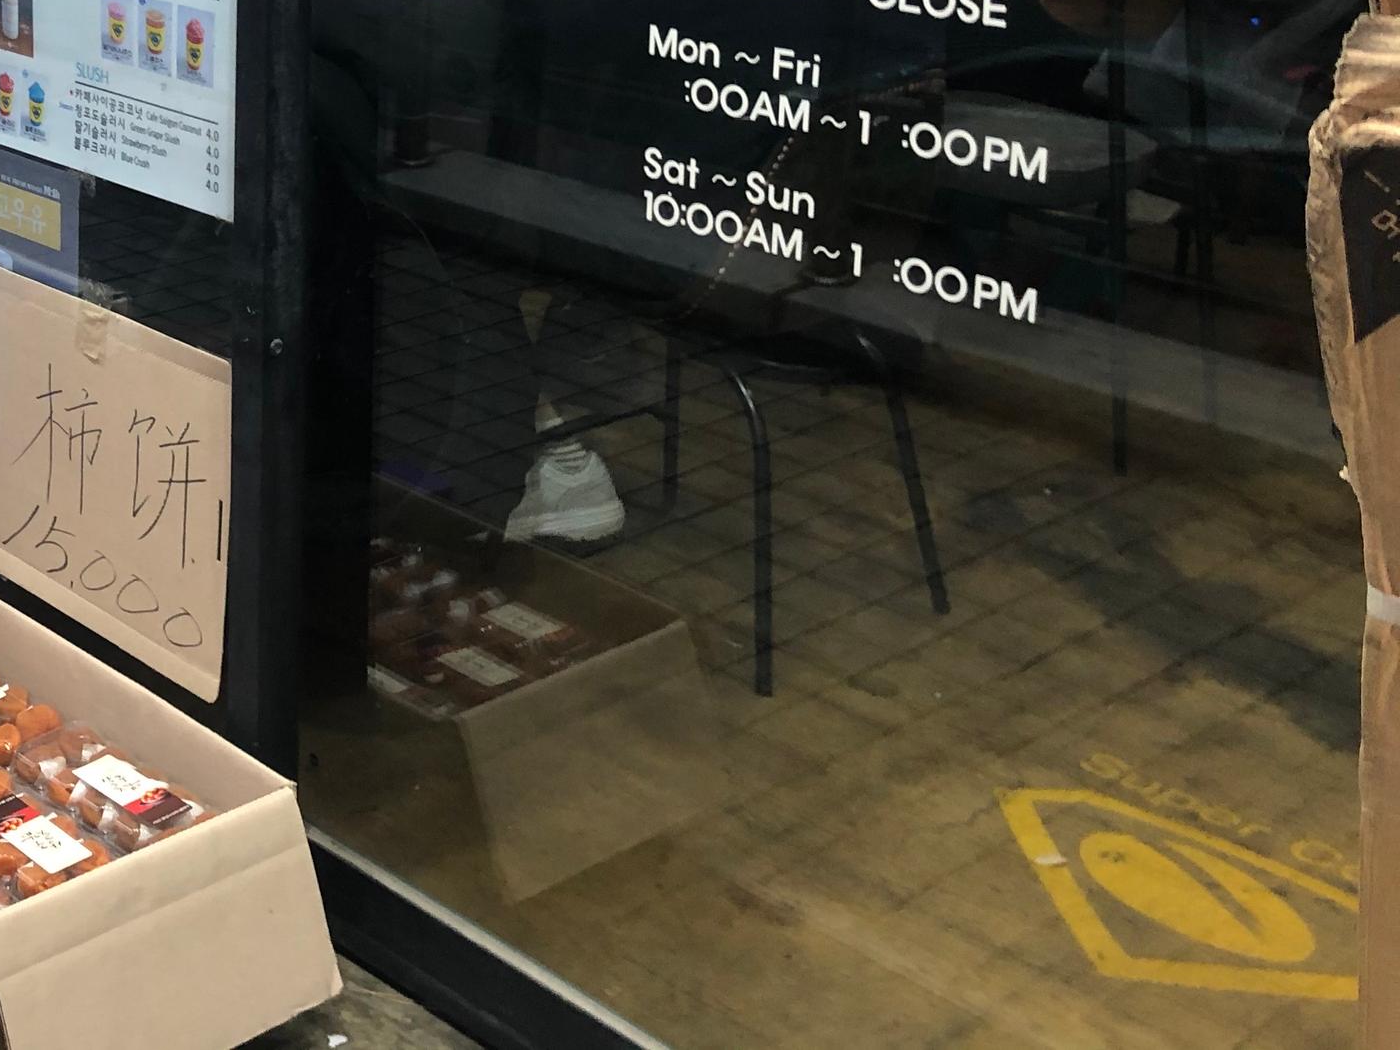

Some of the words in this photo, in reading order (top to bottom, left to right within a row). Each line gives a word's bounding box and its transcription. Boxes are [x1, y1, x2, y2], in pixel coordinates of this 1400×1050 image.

[648, 24, 720, 68] Mon
[772, 46, 821, 88] Fri
[76, 62, 109, 83] SLUSH
[207, 129, 219, 142] 4.0
[207, 146, 219, 159] 4.0
[206, 163, 219, 176] 4.0
[206, 181, 219, 194] 4.0
[643, 146, 700, 190] Sat
[745, 171, 816, 219] Sun
[643, 189, 803, 262] 10:00AM
[12, 362, 207, 570] 柿饼
